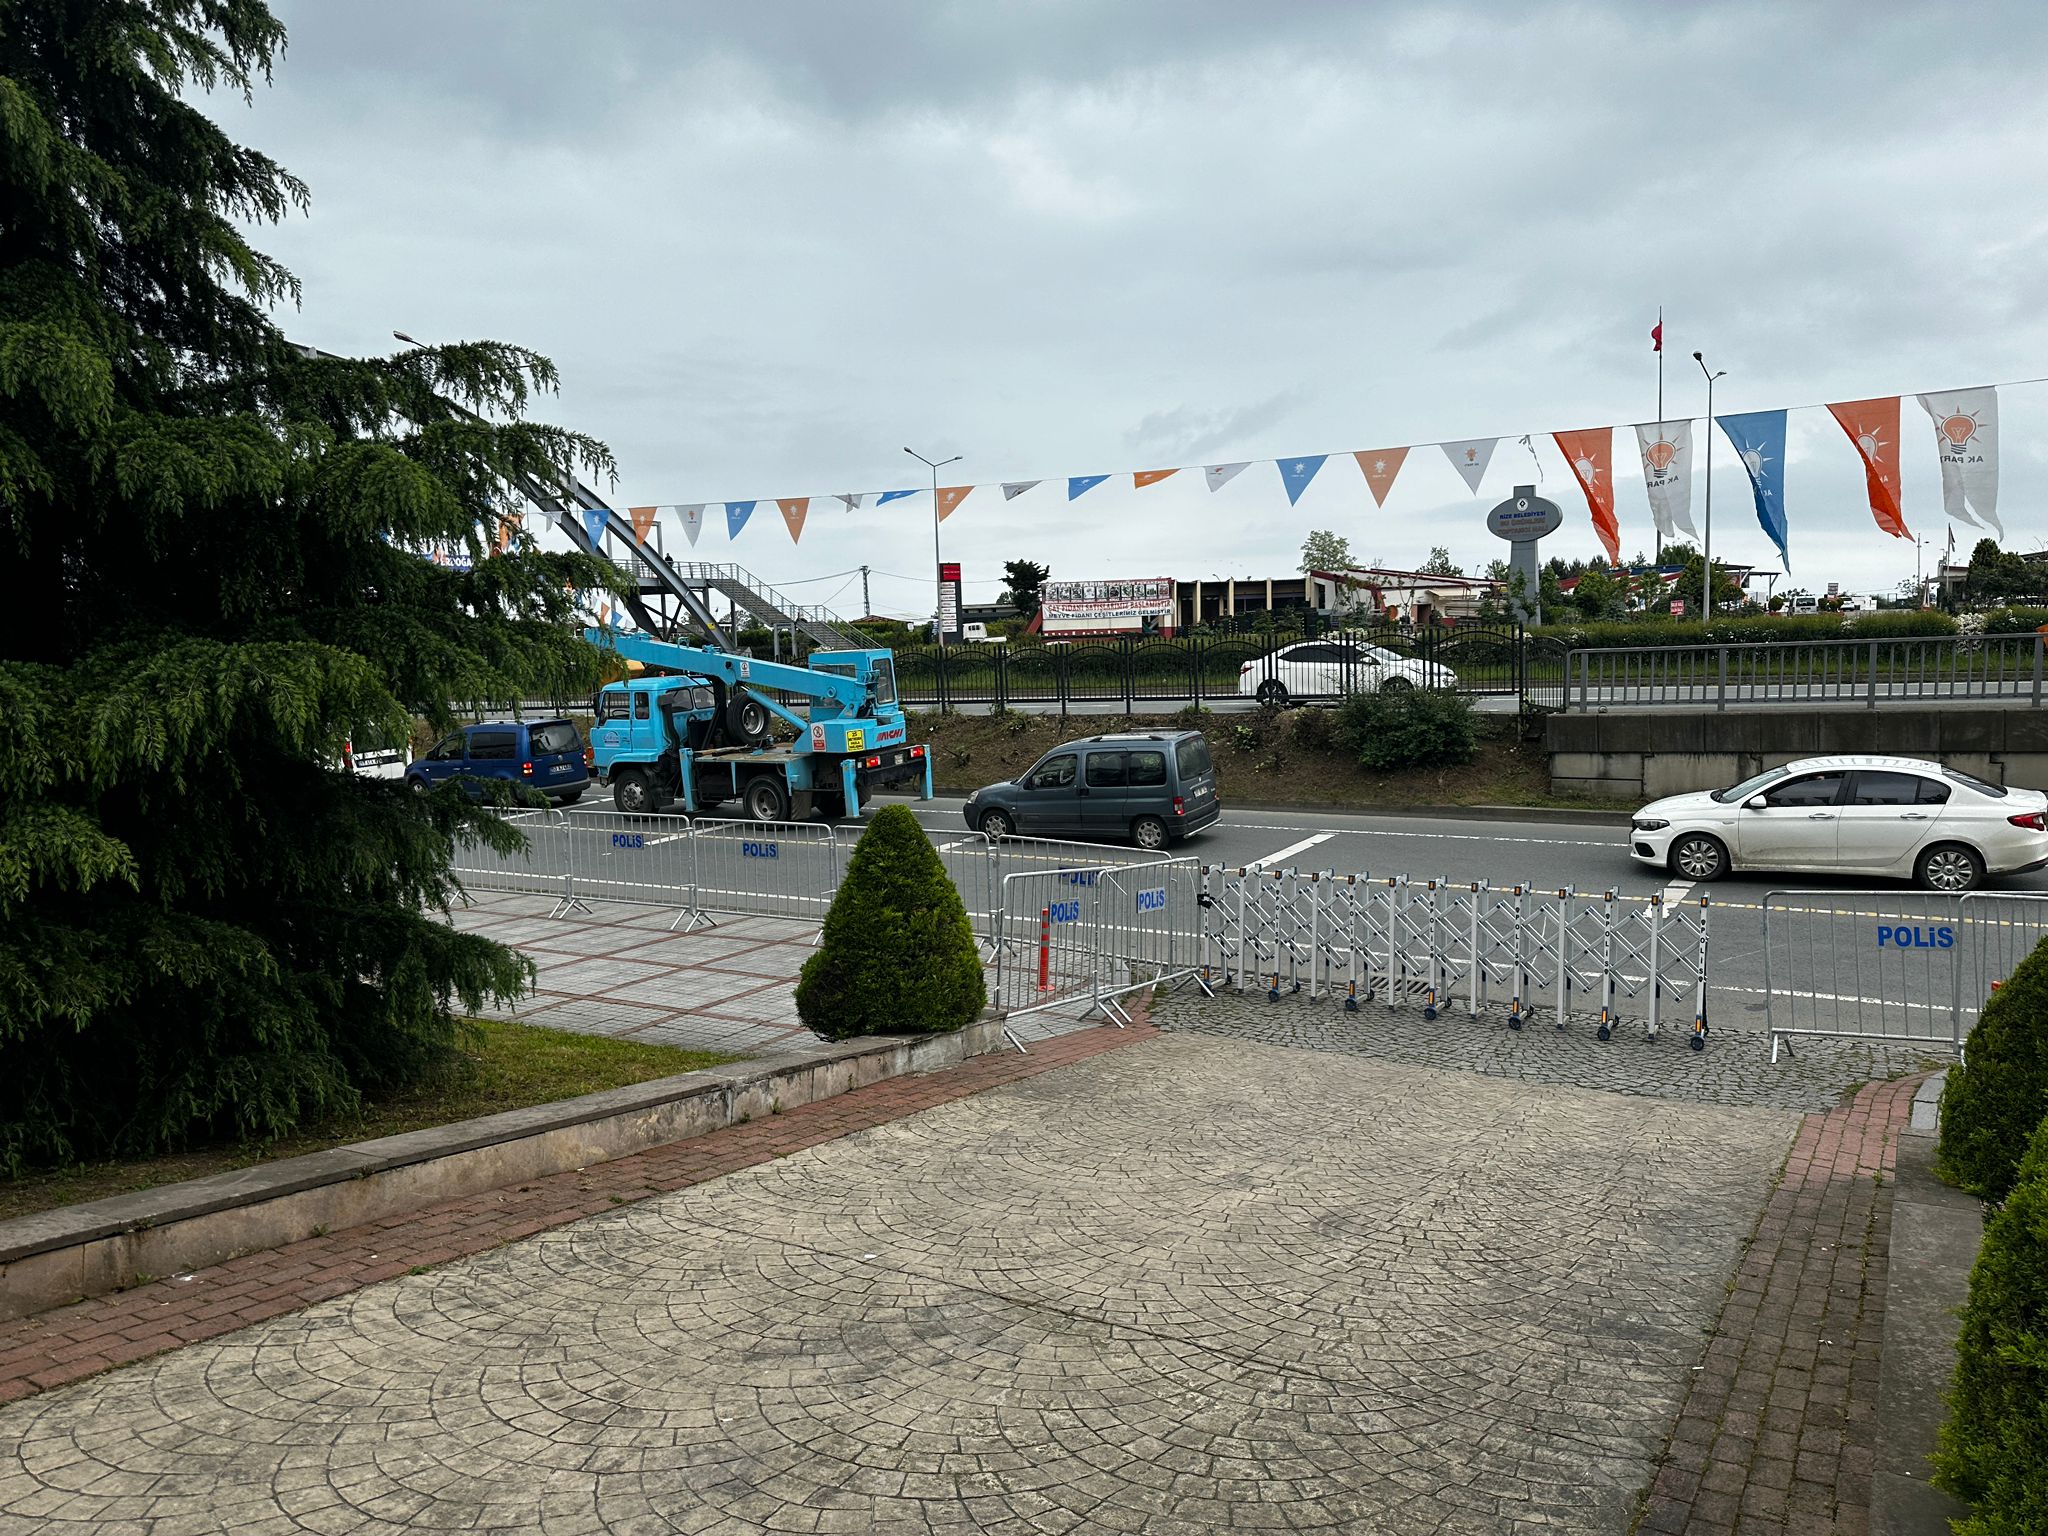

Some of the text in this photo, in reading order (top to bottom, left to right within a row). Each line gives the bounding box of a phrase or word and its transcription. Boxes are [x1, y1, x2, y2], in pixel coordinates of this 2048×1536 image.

[441, 556, 474, 567] ERDOĞA
[612, 834, 643, 849] POLiS
[742, 842, 777, 858] POLiS
[1138, 889, 1165, 911] POLiS
[1050, 901, 1079, 923] POLiS
[1877, 925, 1954, 948] POLiS
